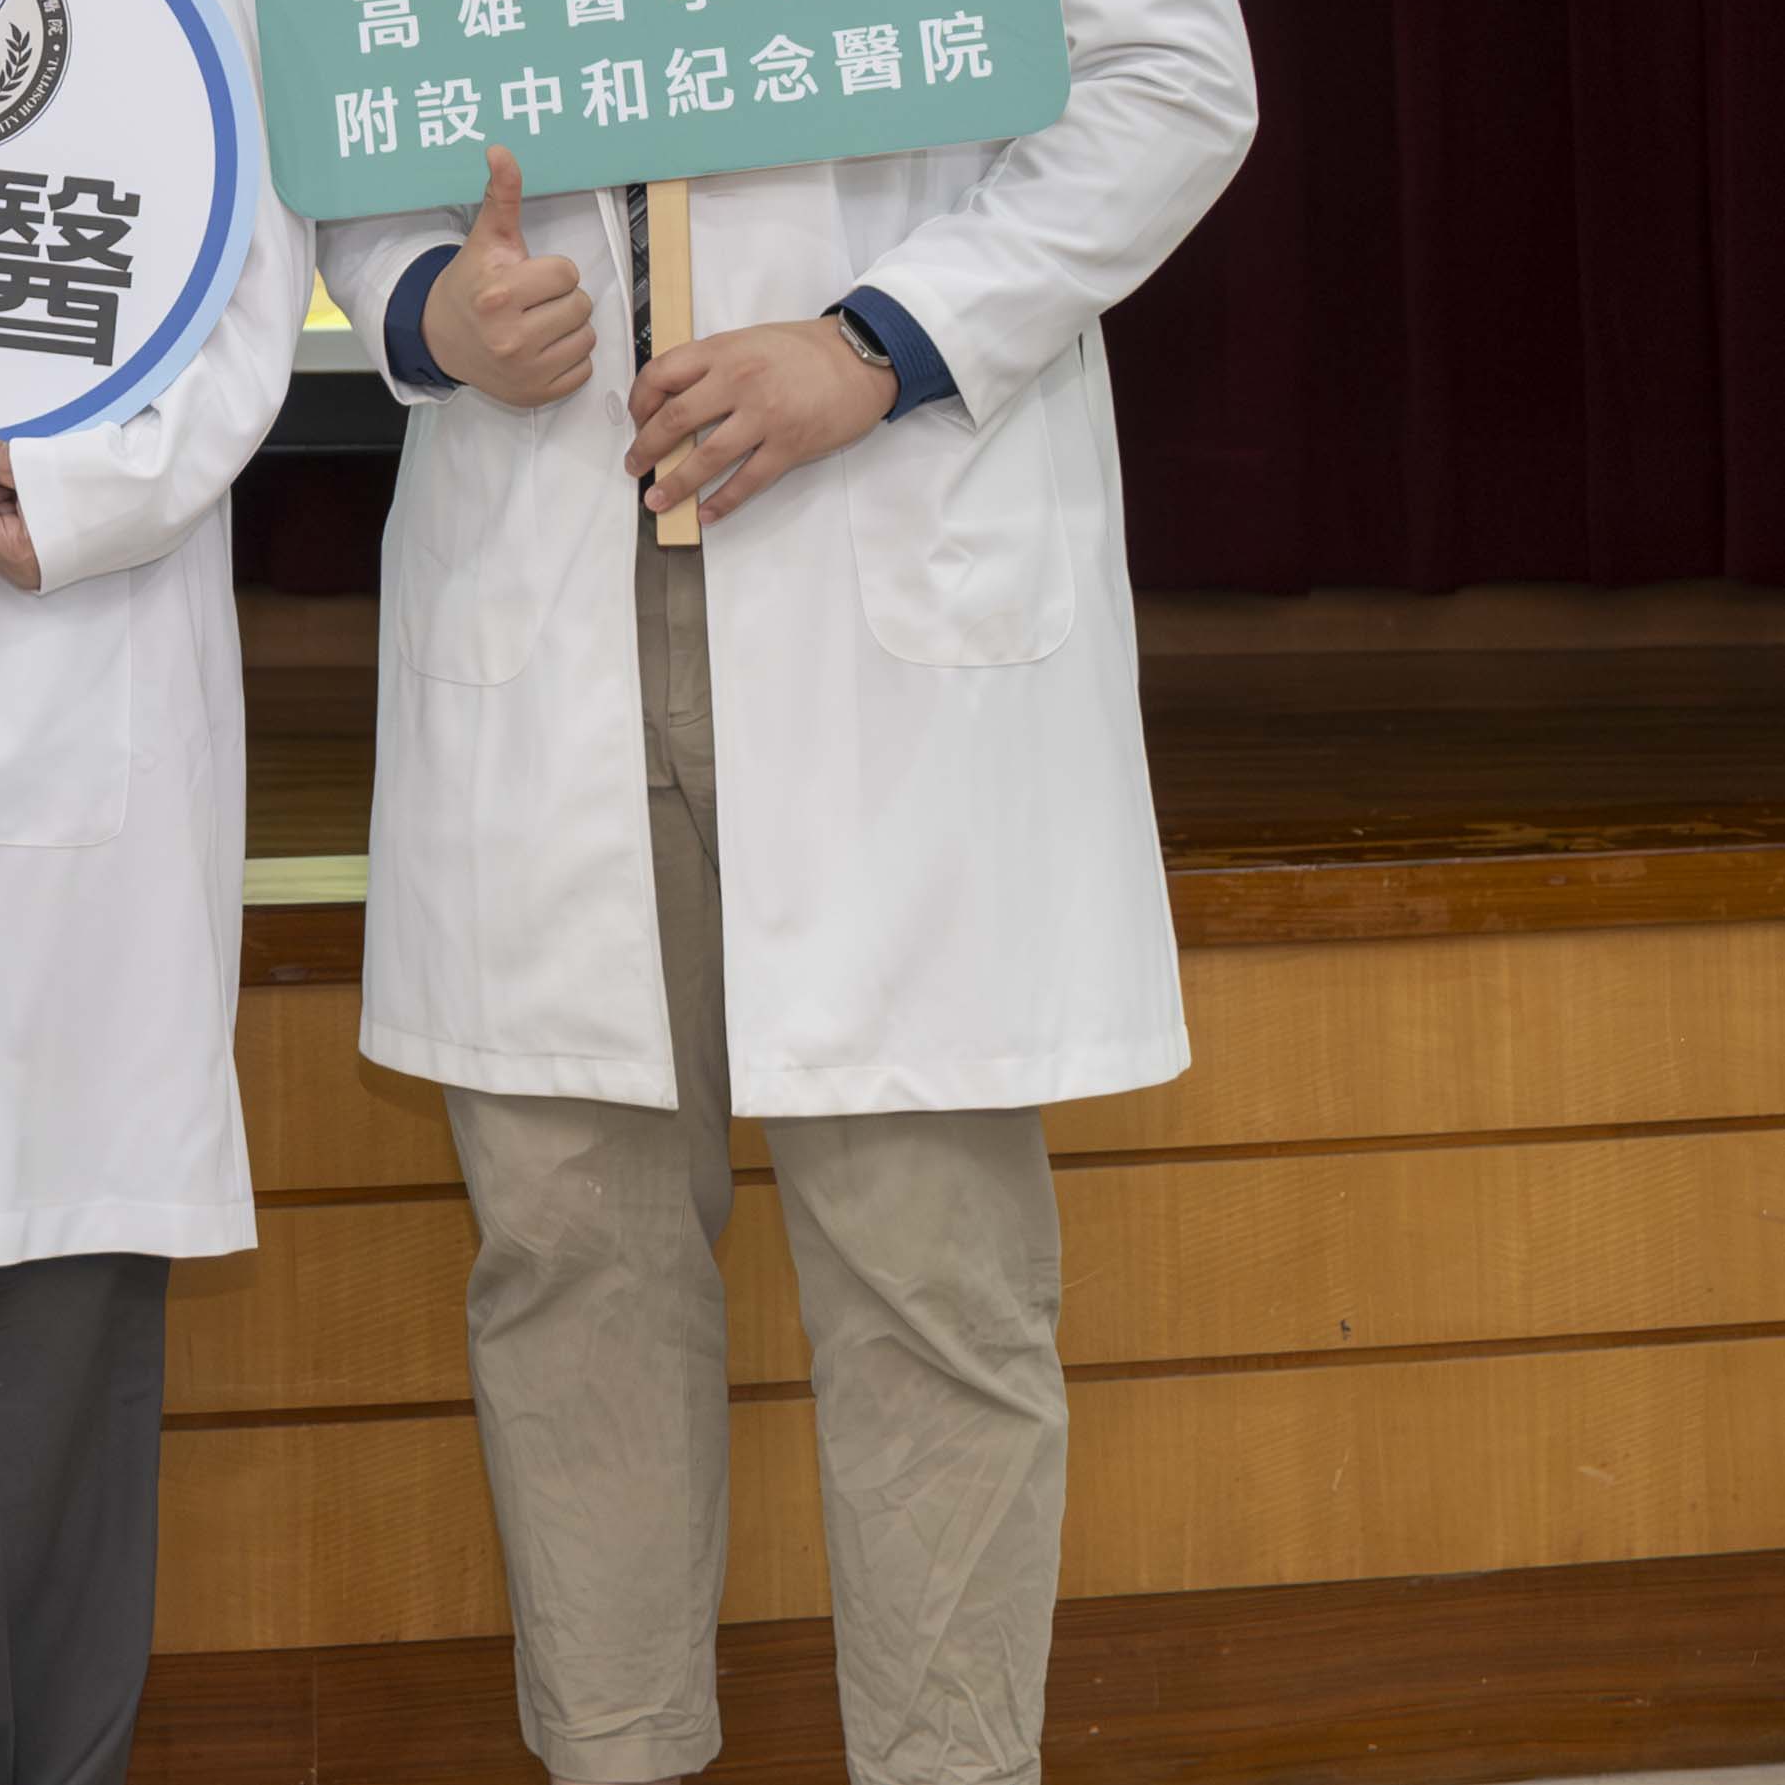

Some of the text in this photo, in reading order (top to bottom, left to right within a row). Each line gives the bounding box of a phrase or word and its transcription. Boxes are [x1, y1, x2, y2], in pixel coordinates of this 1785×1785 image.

[19, 56, 61, 118] HOSPITAL
[335, 11, 993, 158] 附設中和紀念醫院
